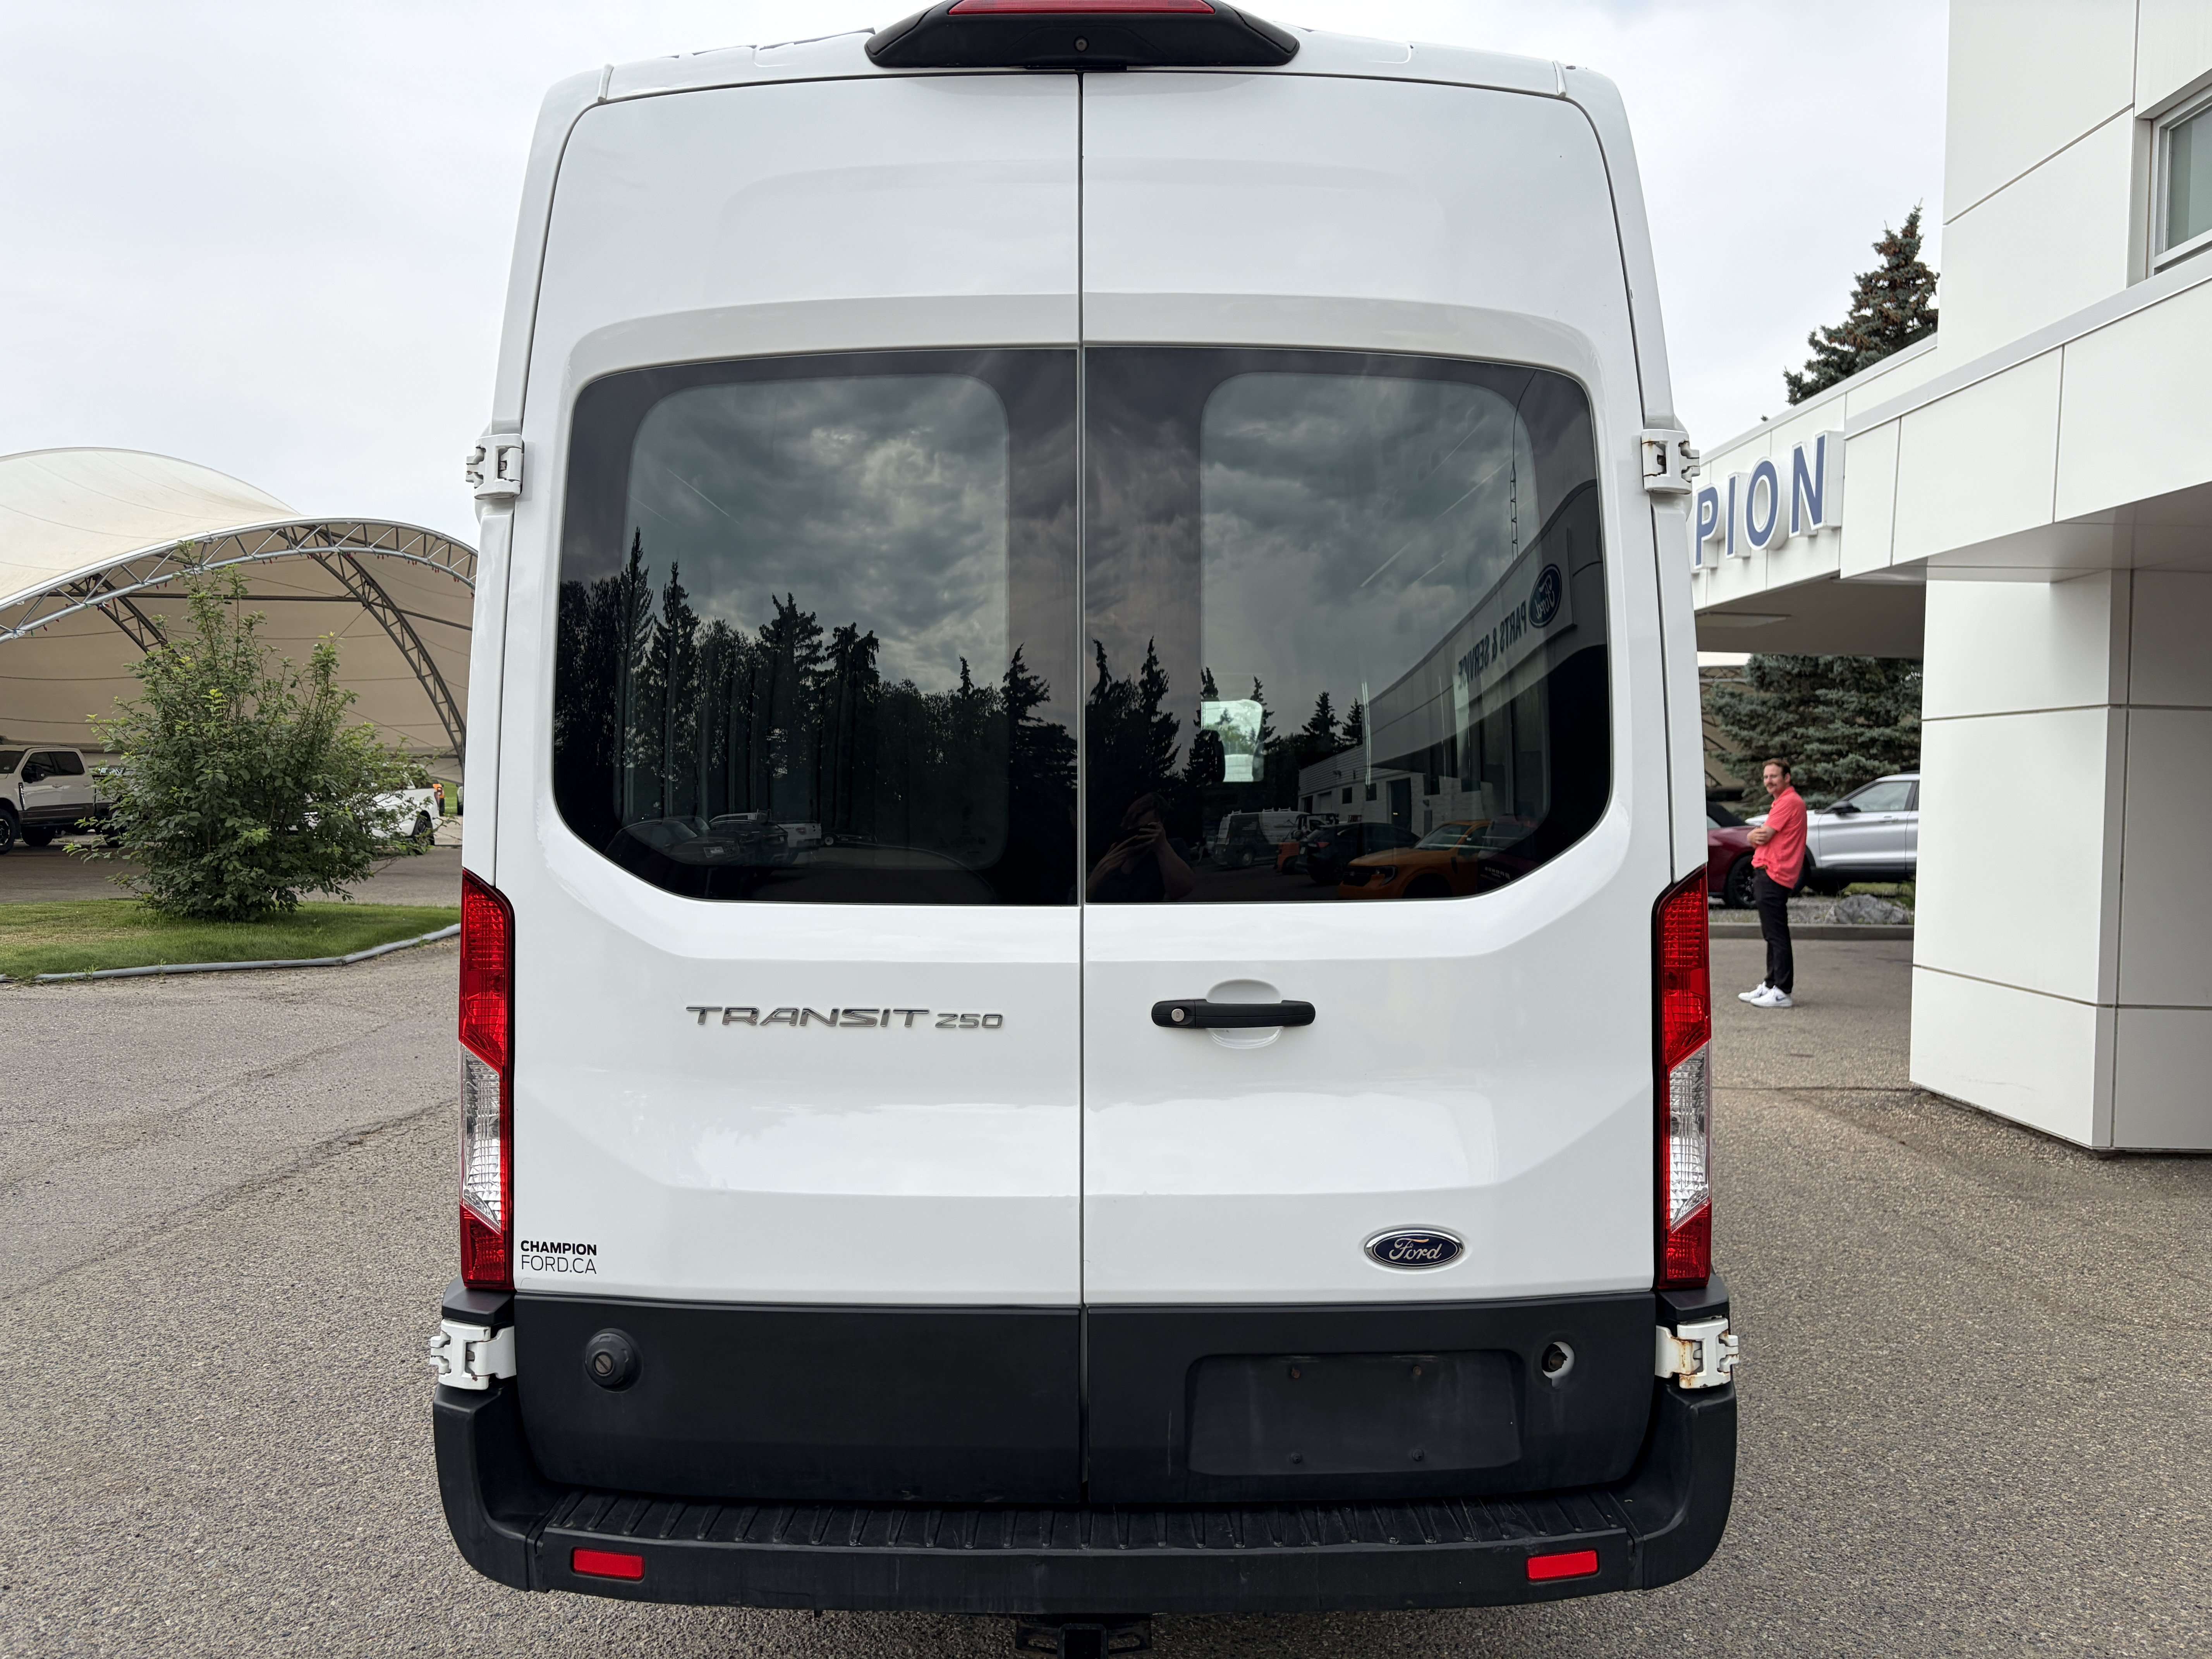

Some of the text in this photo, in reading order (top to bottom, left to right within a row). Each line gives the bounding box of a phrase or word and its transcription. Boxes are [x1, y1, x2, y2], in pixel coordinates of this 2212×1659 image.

[686, 1005, 1003, 1028] TRANSIT 250
[520, 1240, 597, 1256] CHAMPION
[1389, 1238, 1443, 1260] Ford
[521, 1254, 597, 1274] FORD.CA
